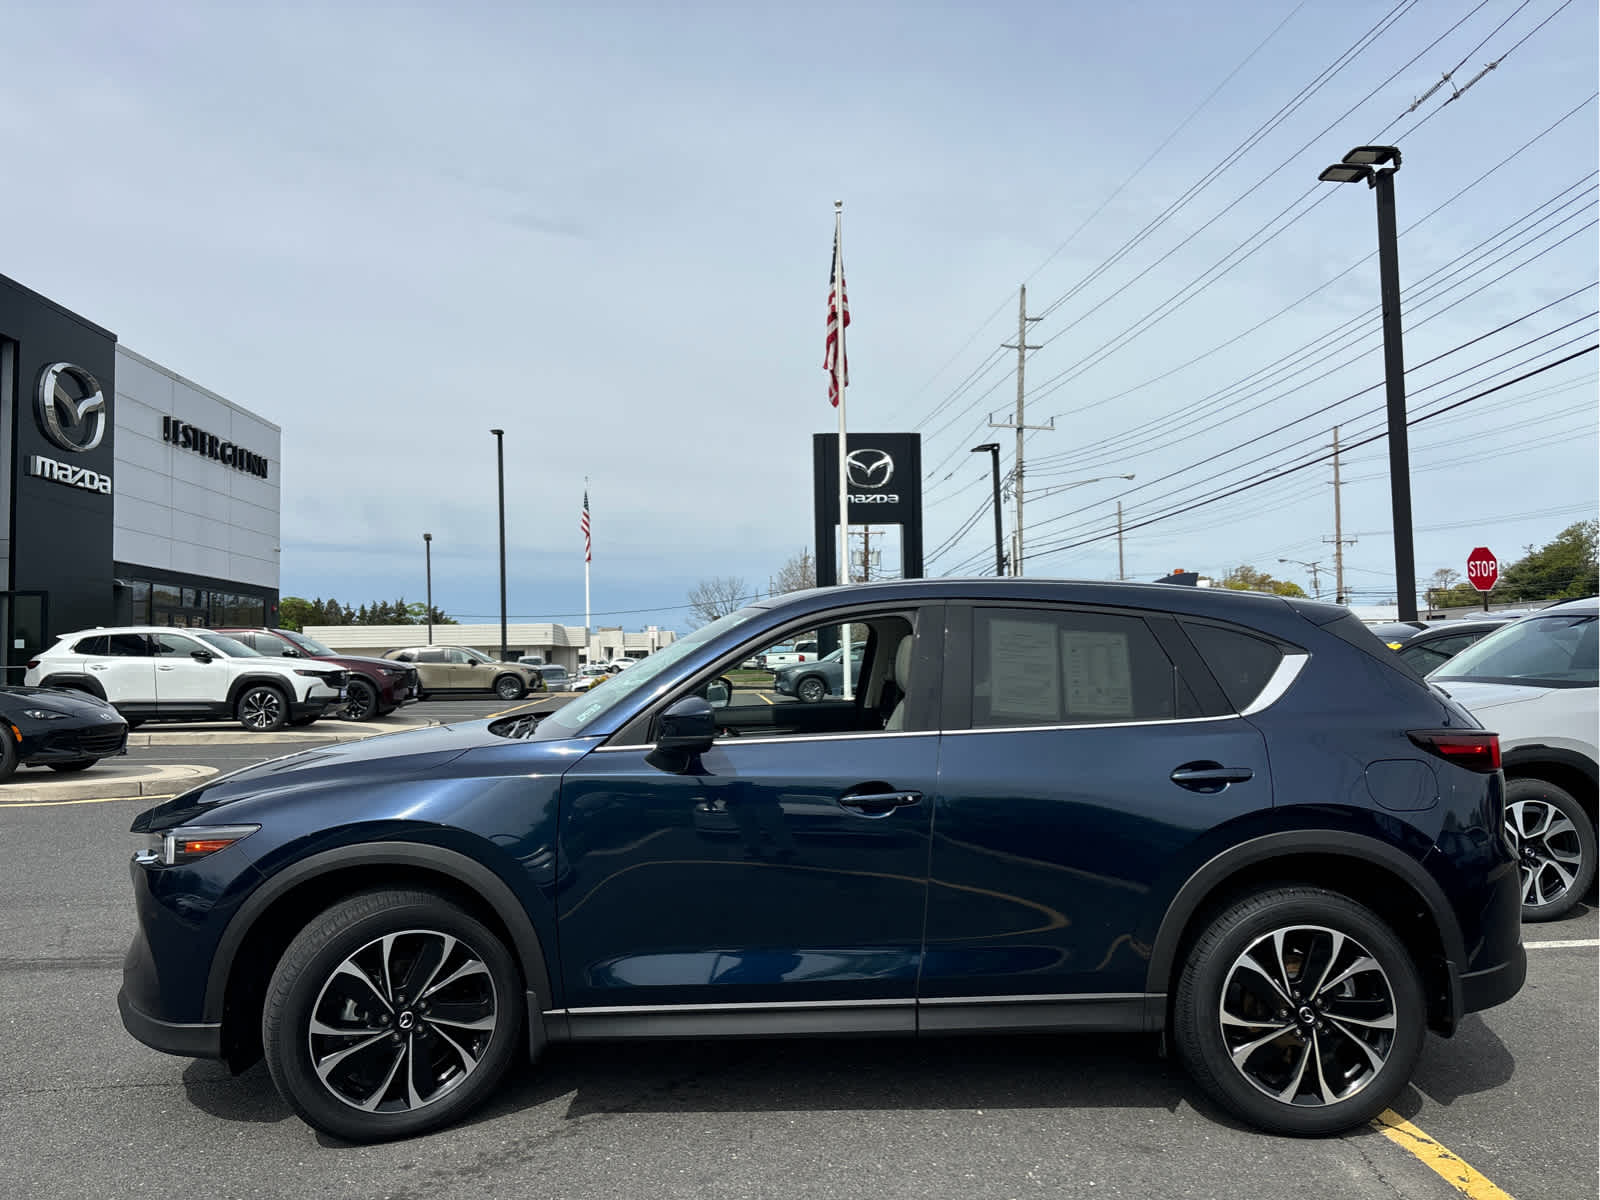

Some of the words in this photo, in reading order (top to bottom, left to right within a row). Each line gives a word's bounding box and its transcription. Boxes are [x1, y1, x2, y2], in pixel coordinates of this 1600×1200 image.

[162, 415, 220, 461] LESTER
[32, 455, 112, 495] mazda
[1469, 560, 1496, 577] STOP
